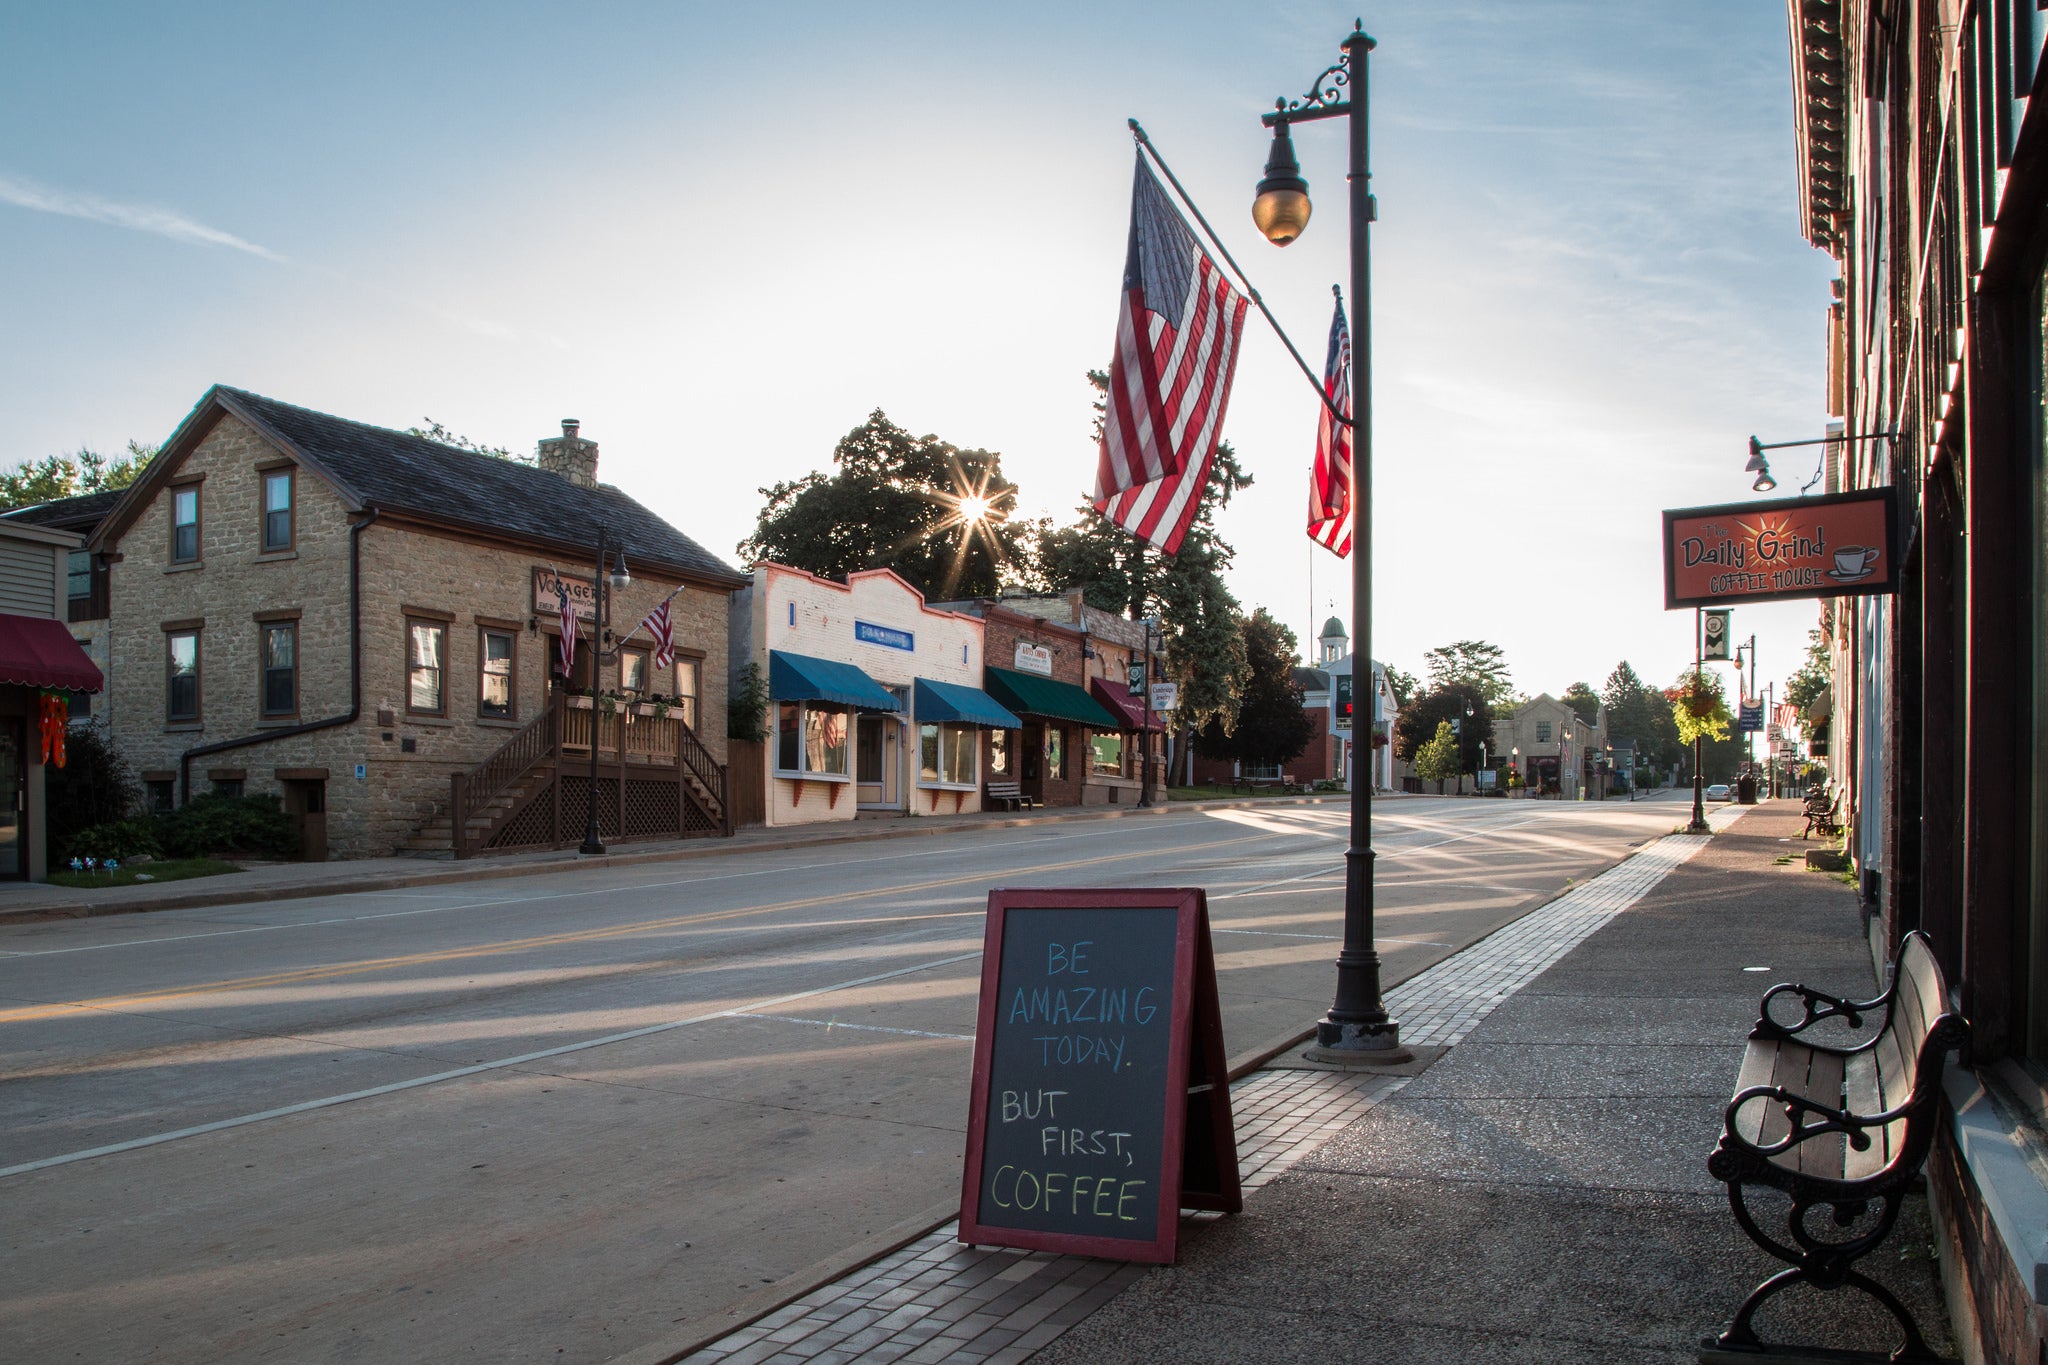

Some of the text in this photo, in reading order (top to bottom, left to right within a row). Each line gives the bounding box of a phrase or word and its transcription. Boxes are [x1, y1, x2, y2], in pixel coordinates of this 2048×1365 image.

[1681, 526, 1825, 568] Daily Grind
[1702, 524, 1728, 538] The
[1710, 567, 1824, 593] COFFEE HOUSE
[1769, 733, 1781, 741] 25
[1048, 941, 1093, 975] BE
[1009, 987, 1157, 1025] AMAZING
[1002, 1089, 1069, 1123] BUT
[1042, 1127, 1133, 1167] FIRST,
[992, 1165, 1146, 1221] COFFEE
